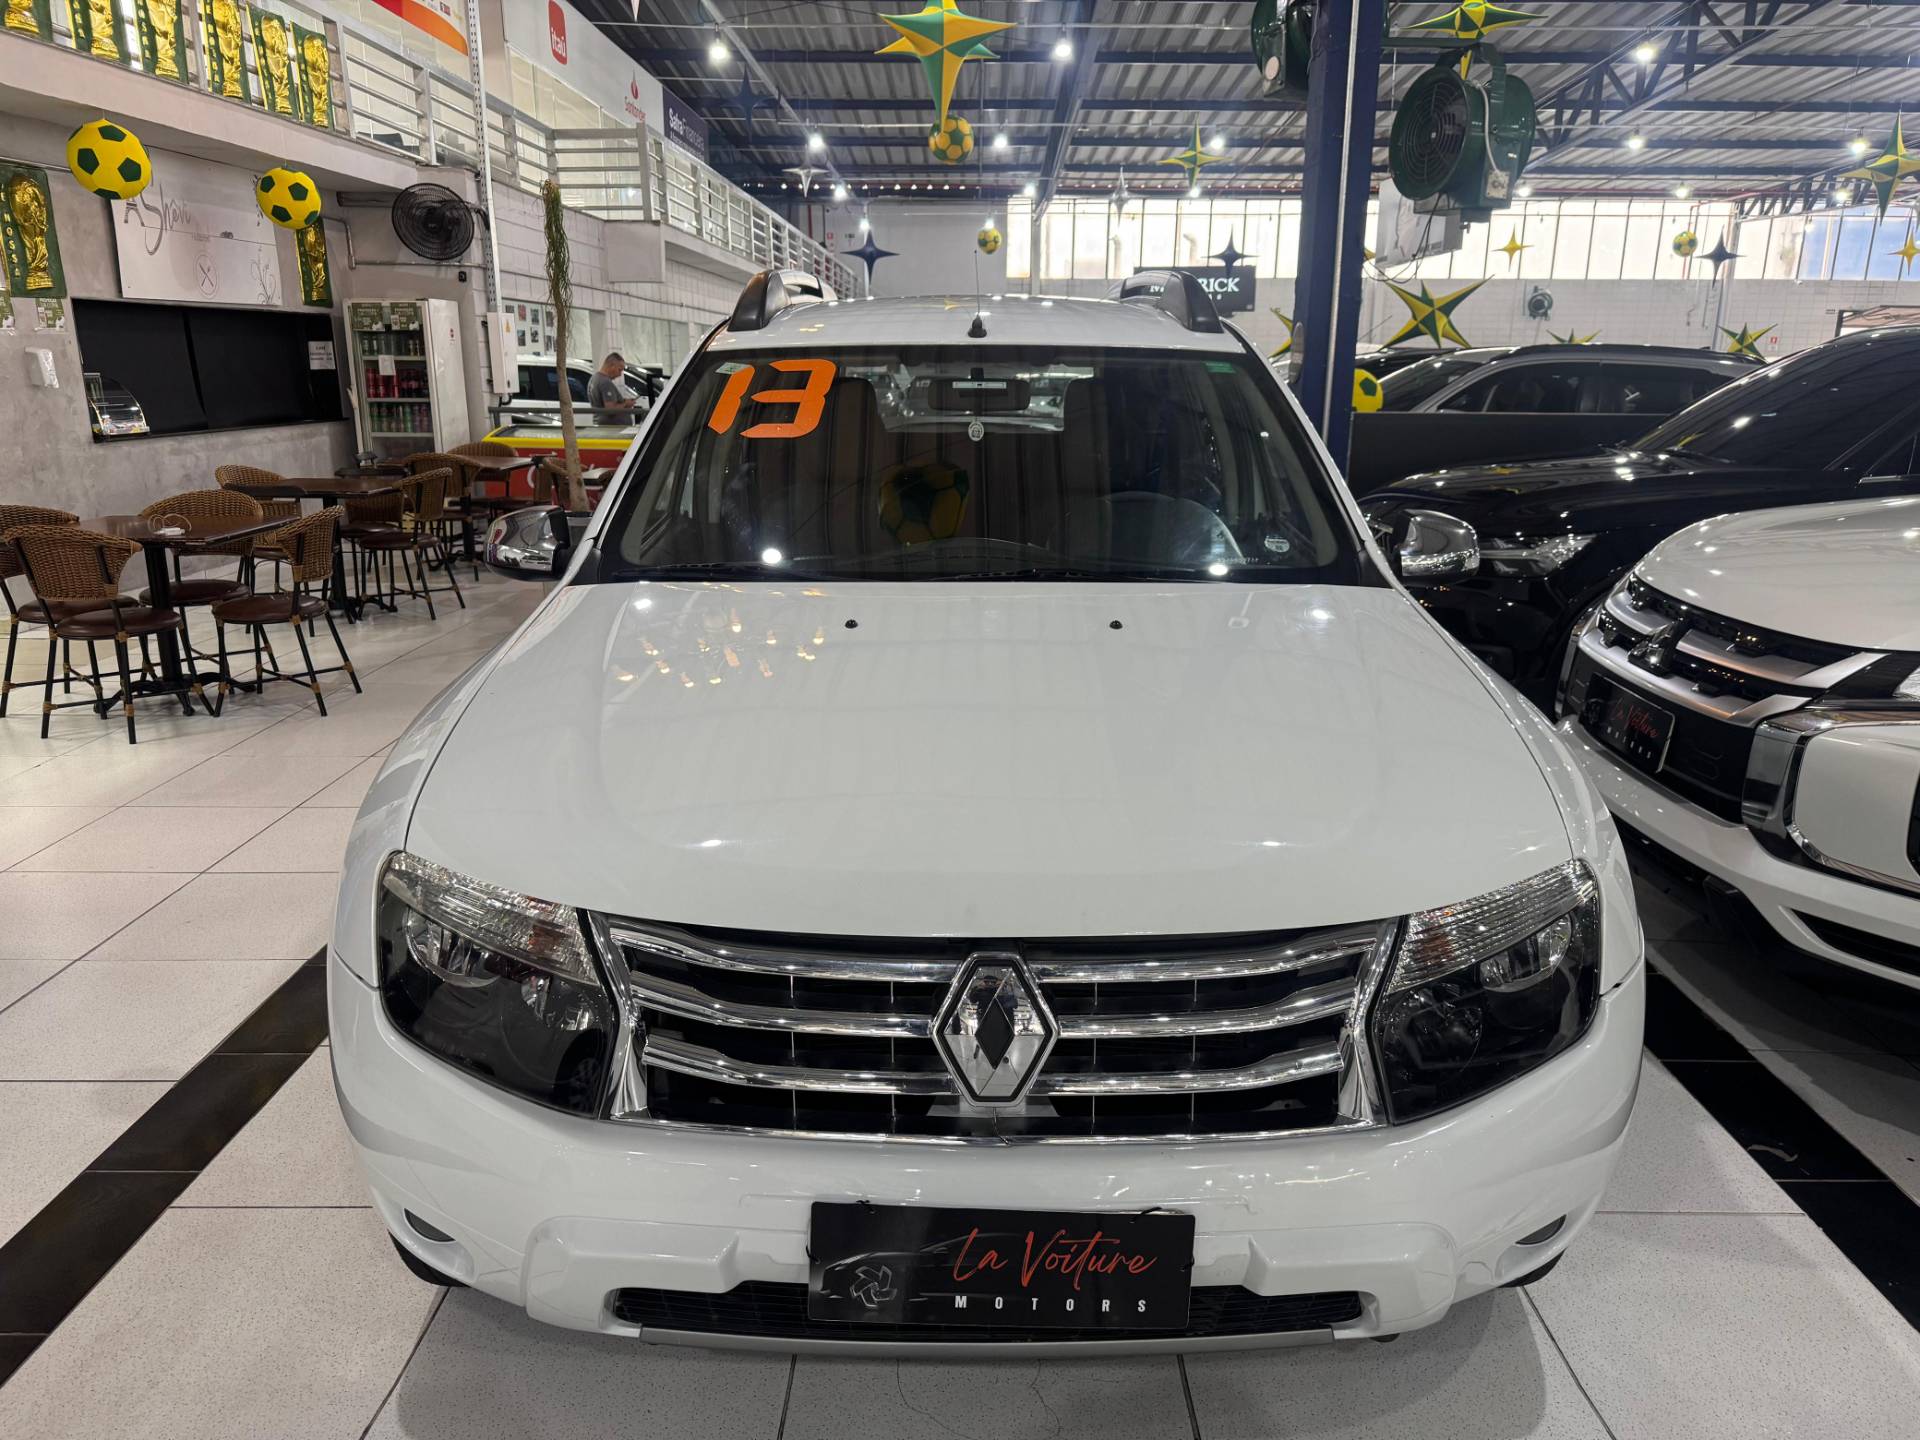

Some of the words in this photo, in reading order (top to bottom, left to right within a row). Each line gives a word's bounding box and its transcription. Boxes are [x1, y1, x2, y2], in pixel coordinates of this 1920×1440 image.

[550, 27, 566, 57] itaú
[1197, 277, 1240, 293] RICK
[707, 358, 837, 439] 13
[953, 1226, 1008, 1282] La
[1020, 1228, 1157, 1291] Voiture
[954, 1295, 1147, 1313] MOTORS
